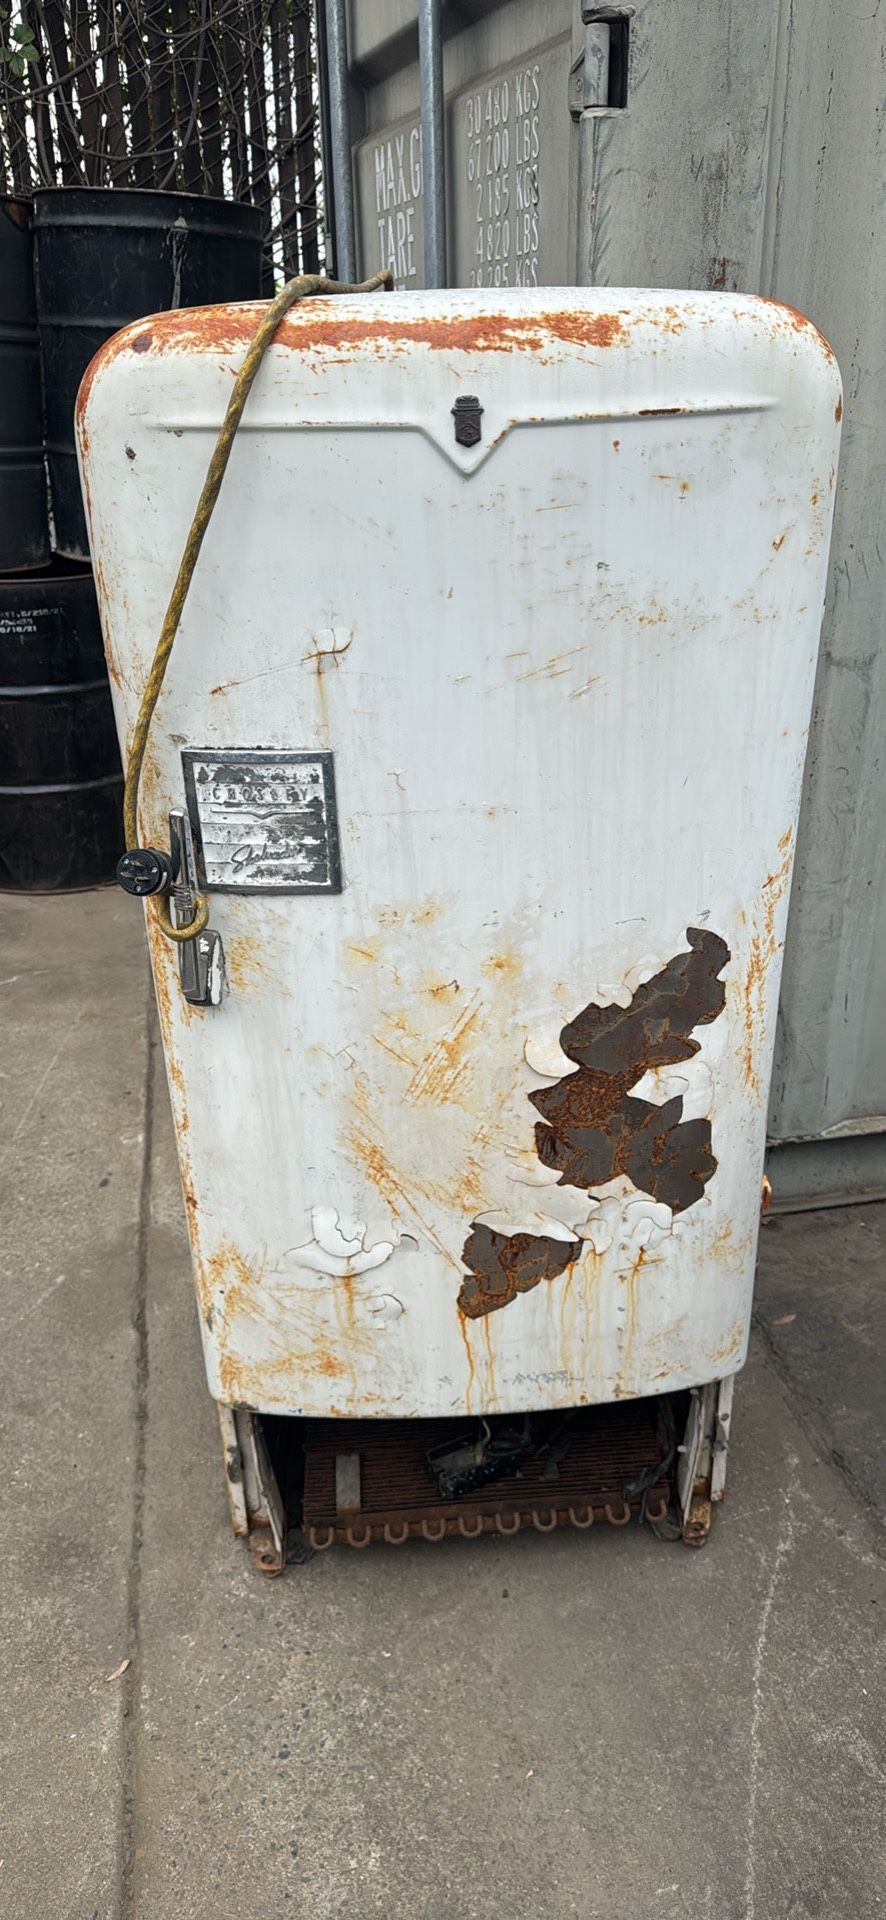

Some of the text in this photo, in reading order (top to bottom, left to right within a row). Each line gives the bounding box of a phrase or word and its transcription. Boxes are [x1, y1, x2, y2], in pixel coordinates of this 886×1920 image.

[516, 65, 540, 117] KGS
[516, 115, 539, 165] LBS
[516, 163, 540, 211] KGS
[378, 206, 417, 280] TARE
[516, 212, 539, 256] LBS
